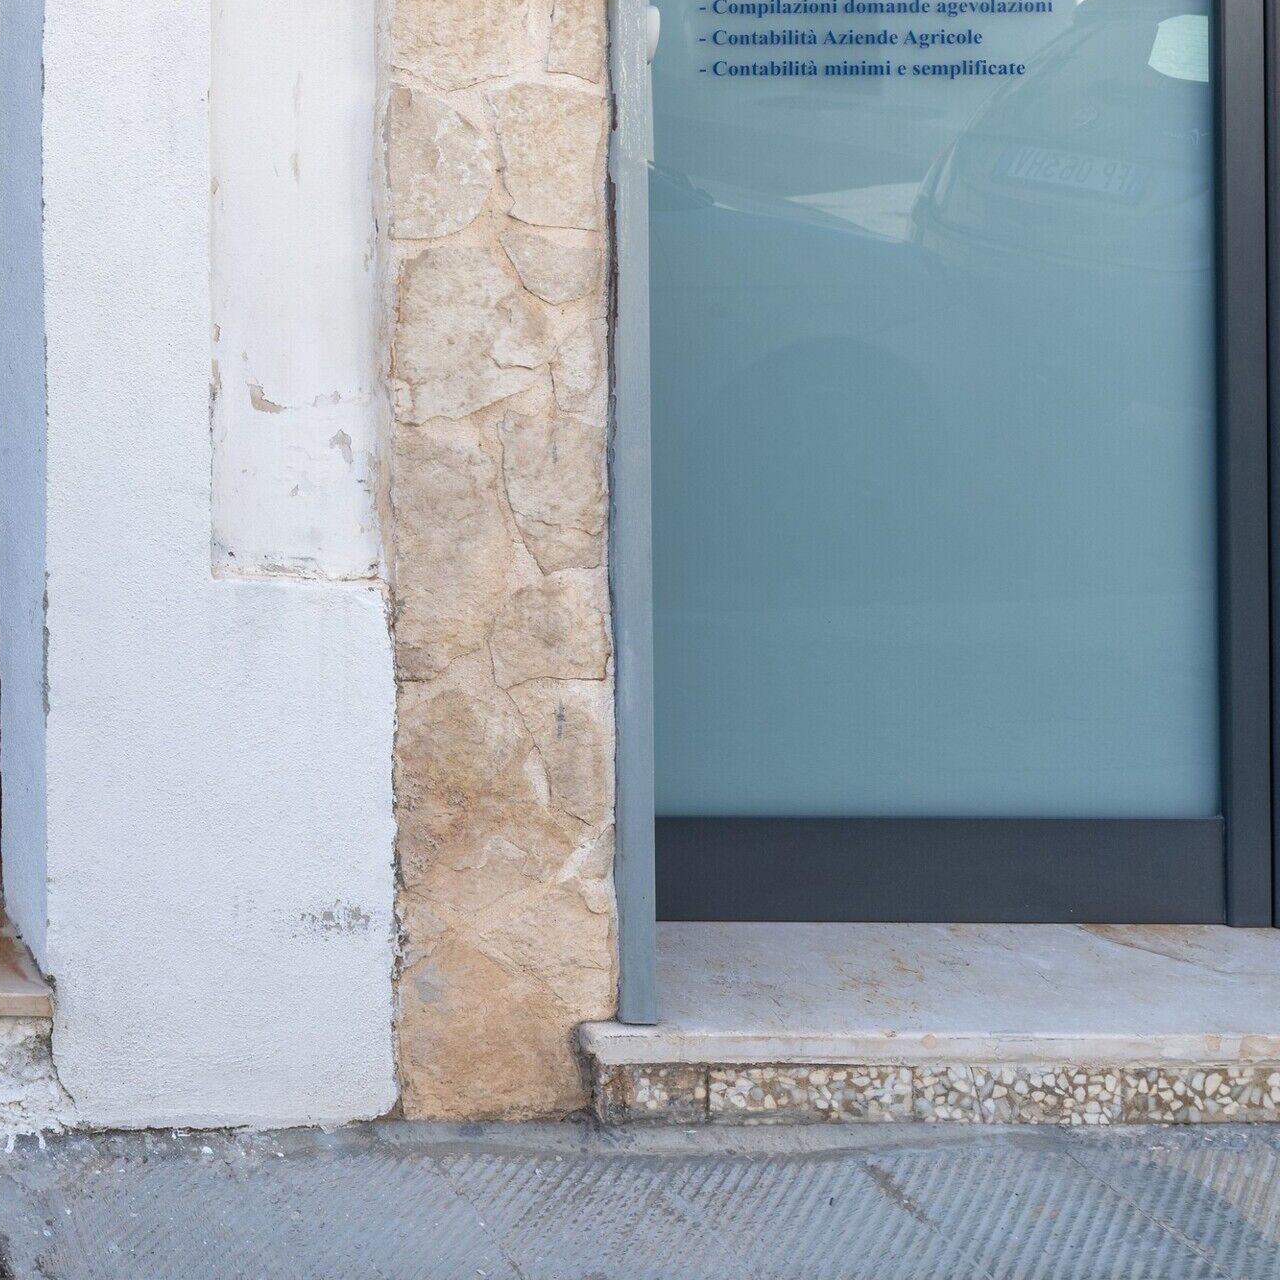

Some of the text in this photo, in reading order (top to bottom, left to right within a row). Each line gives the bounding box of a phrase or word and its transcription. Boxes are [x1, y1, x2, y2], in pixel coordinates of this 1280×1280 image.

[712, 30, 817, 46] Contabilità
[823, 30, 898, 45] Aziende
[904, 29, 983, 48] Agricole
[712, 60, 817, 77] Contabilità
[824, 61, 890, 76] minimi
[897, 65, 906, 76] e
[912, 60, 1026, 79] semplificate
